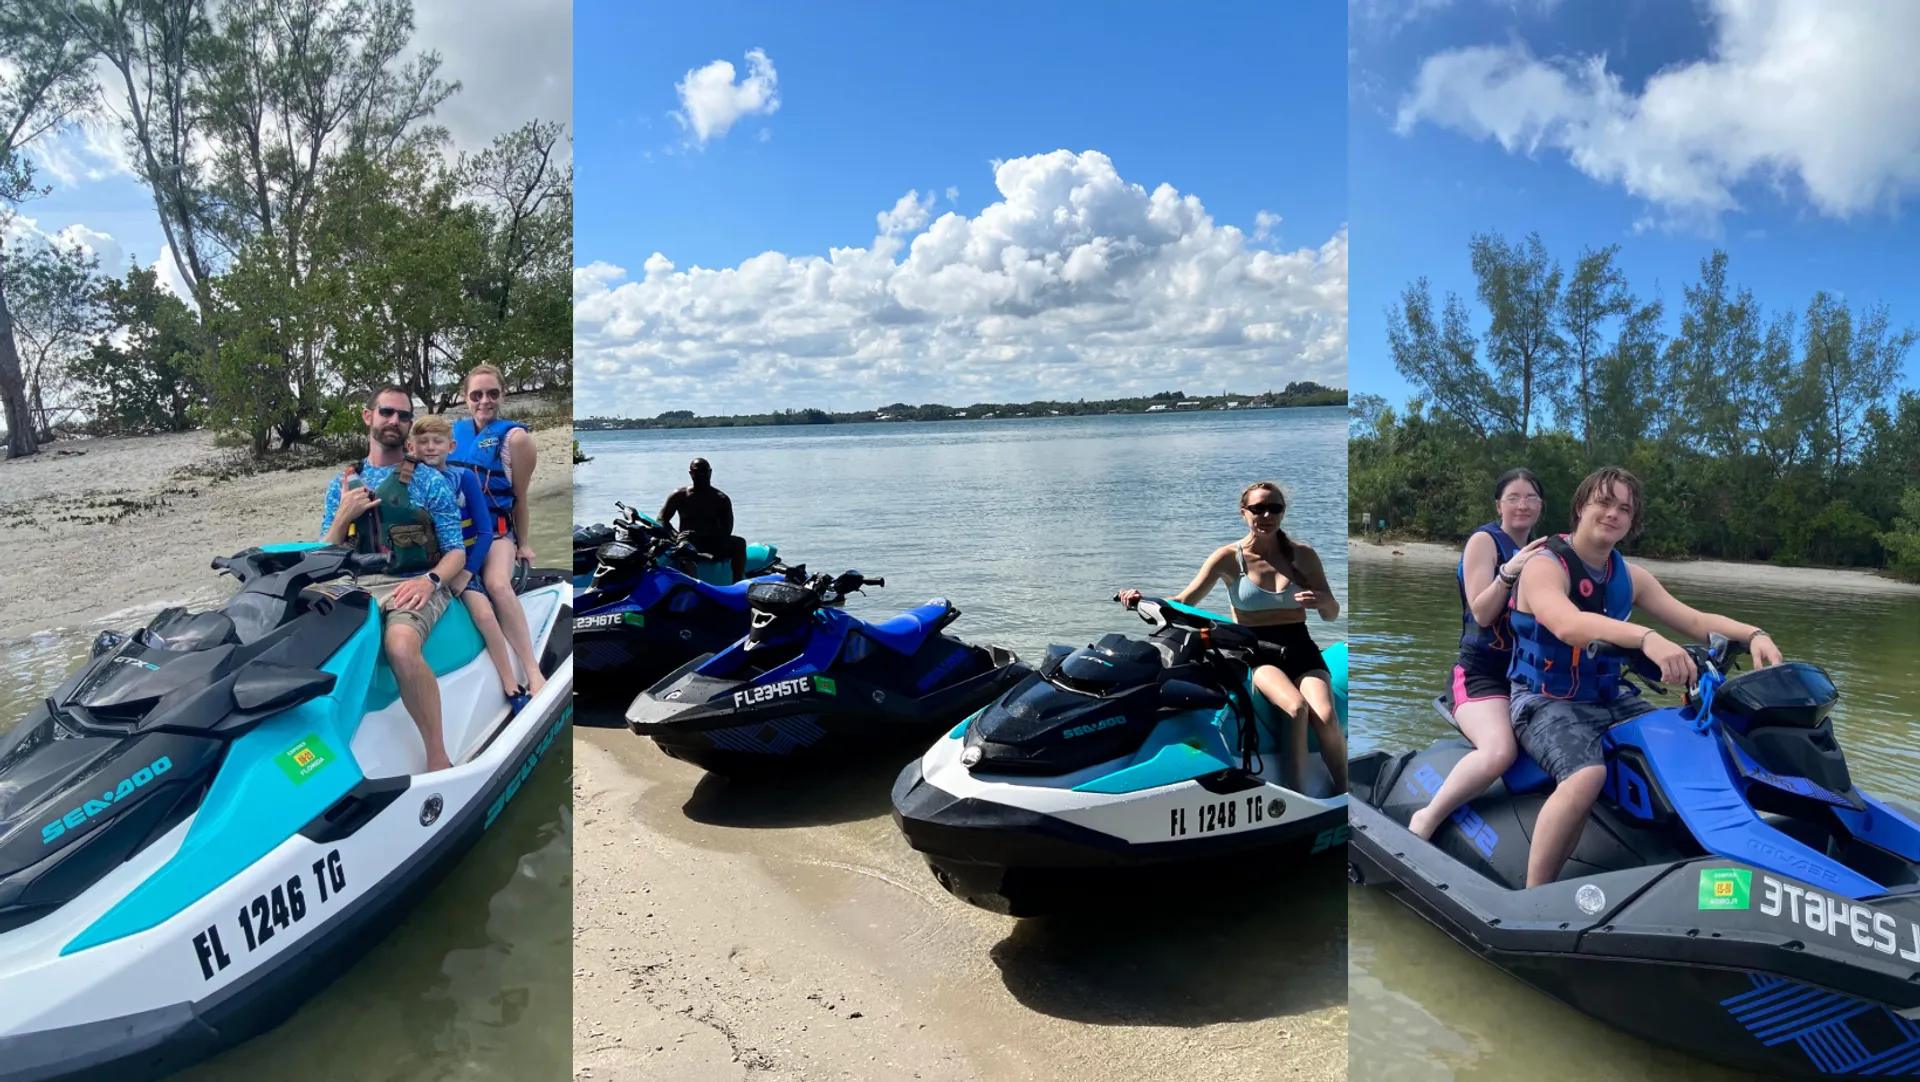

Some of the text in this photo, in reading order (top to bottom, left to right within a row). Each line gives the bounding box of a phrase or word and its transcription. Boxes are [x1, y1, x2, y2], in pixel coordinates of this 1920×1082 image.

[573, 613, 622, 629] 2346TE
[733, 676, 810, 708] FL2345TE
[300, 757, 325, 776] FLORIDA
[1171, 808, 1186, 837] FL
[1199, 800, 1236, 833] 1248
[1247, 795, 1263, 824] TG
[192, 849, 347, 981] FL 1246 TG
